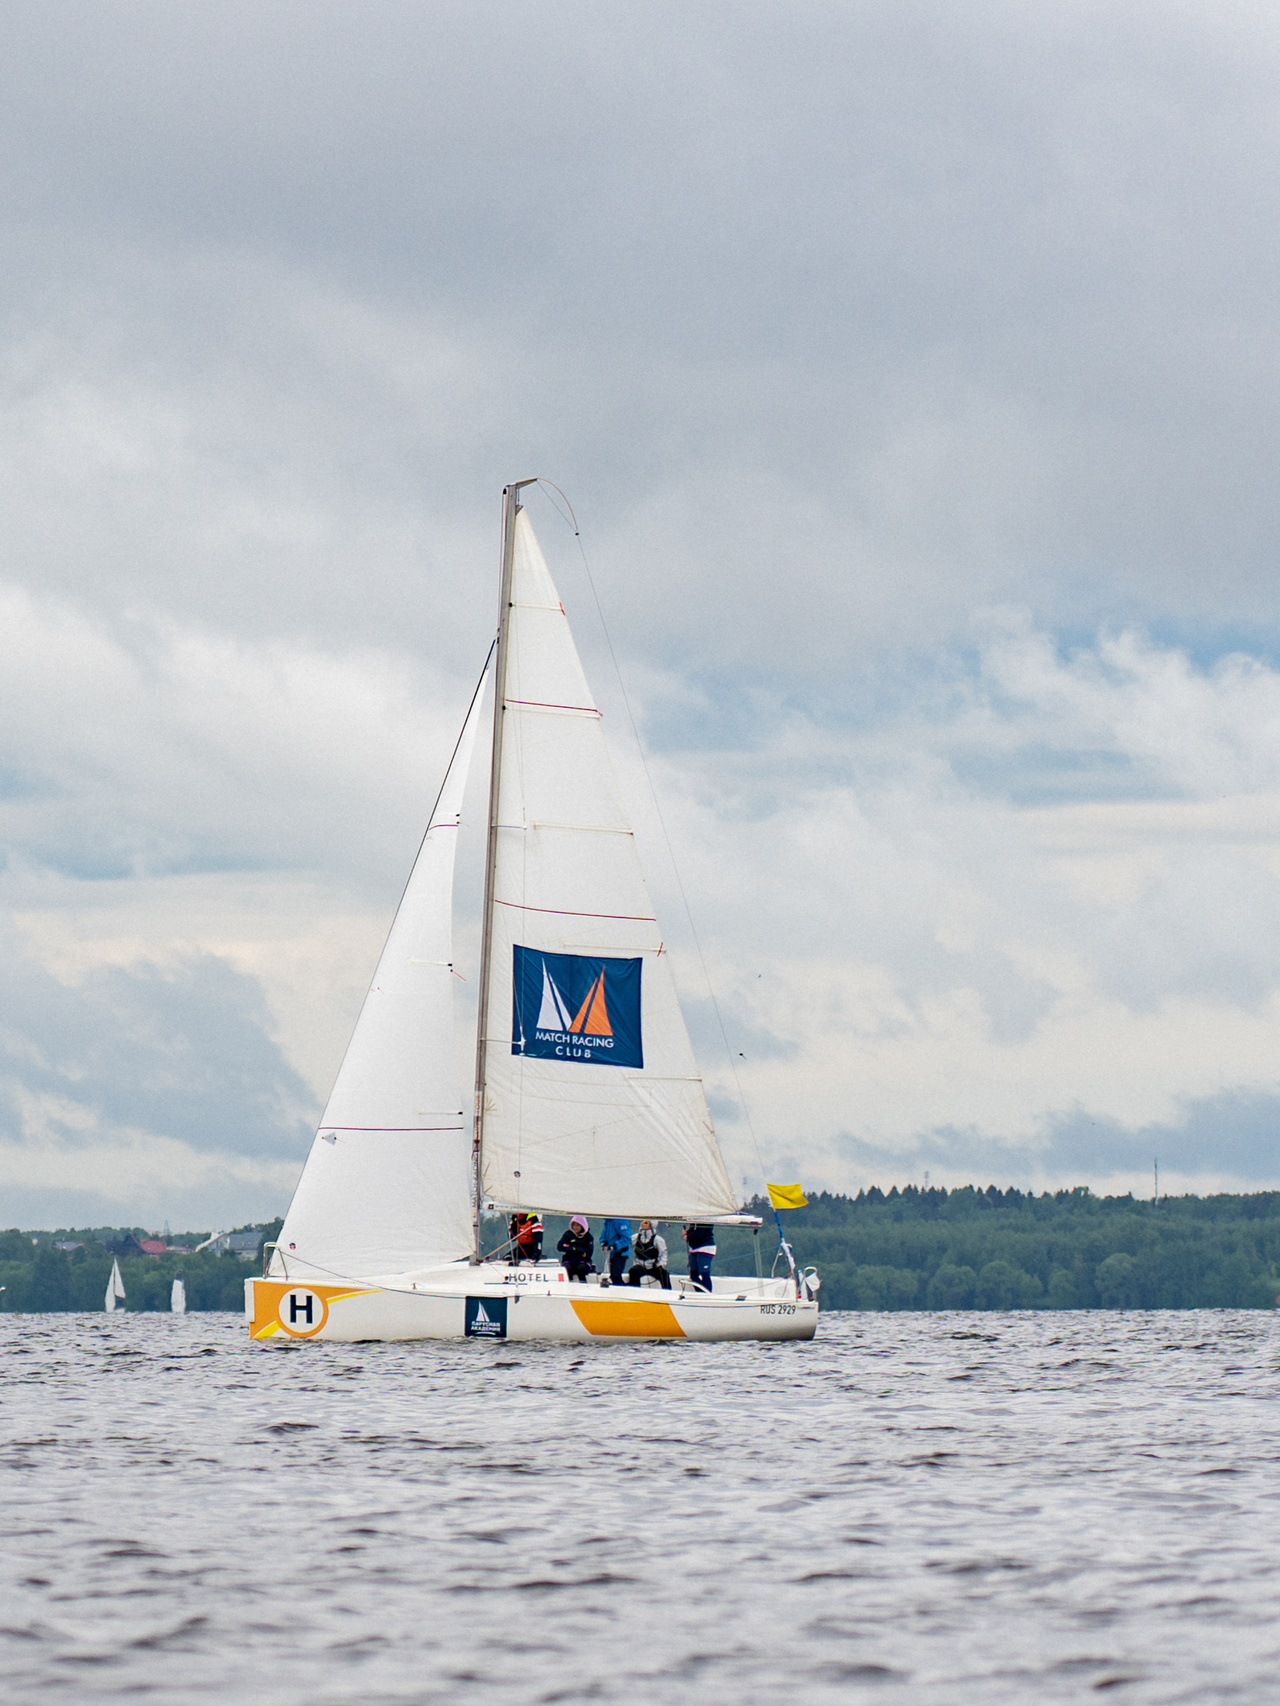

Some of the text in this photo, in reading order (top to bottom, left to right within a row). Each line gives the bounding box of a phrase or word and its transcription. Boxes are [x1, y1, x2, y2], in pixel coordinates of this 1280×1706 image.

[535, 1031, 614, 1048] MATCH RACING
[555, 1046, 592, 1058] CLUB
[508, 1272, 549, 1282] HOTEL
[290, 1294, 313, 1324] H
[760, 1304, 776, 1314] RUS
[777, 1304, 796, 1314] 2929
